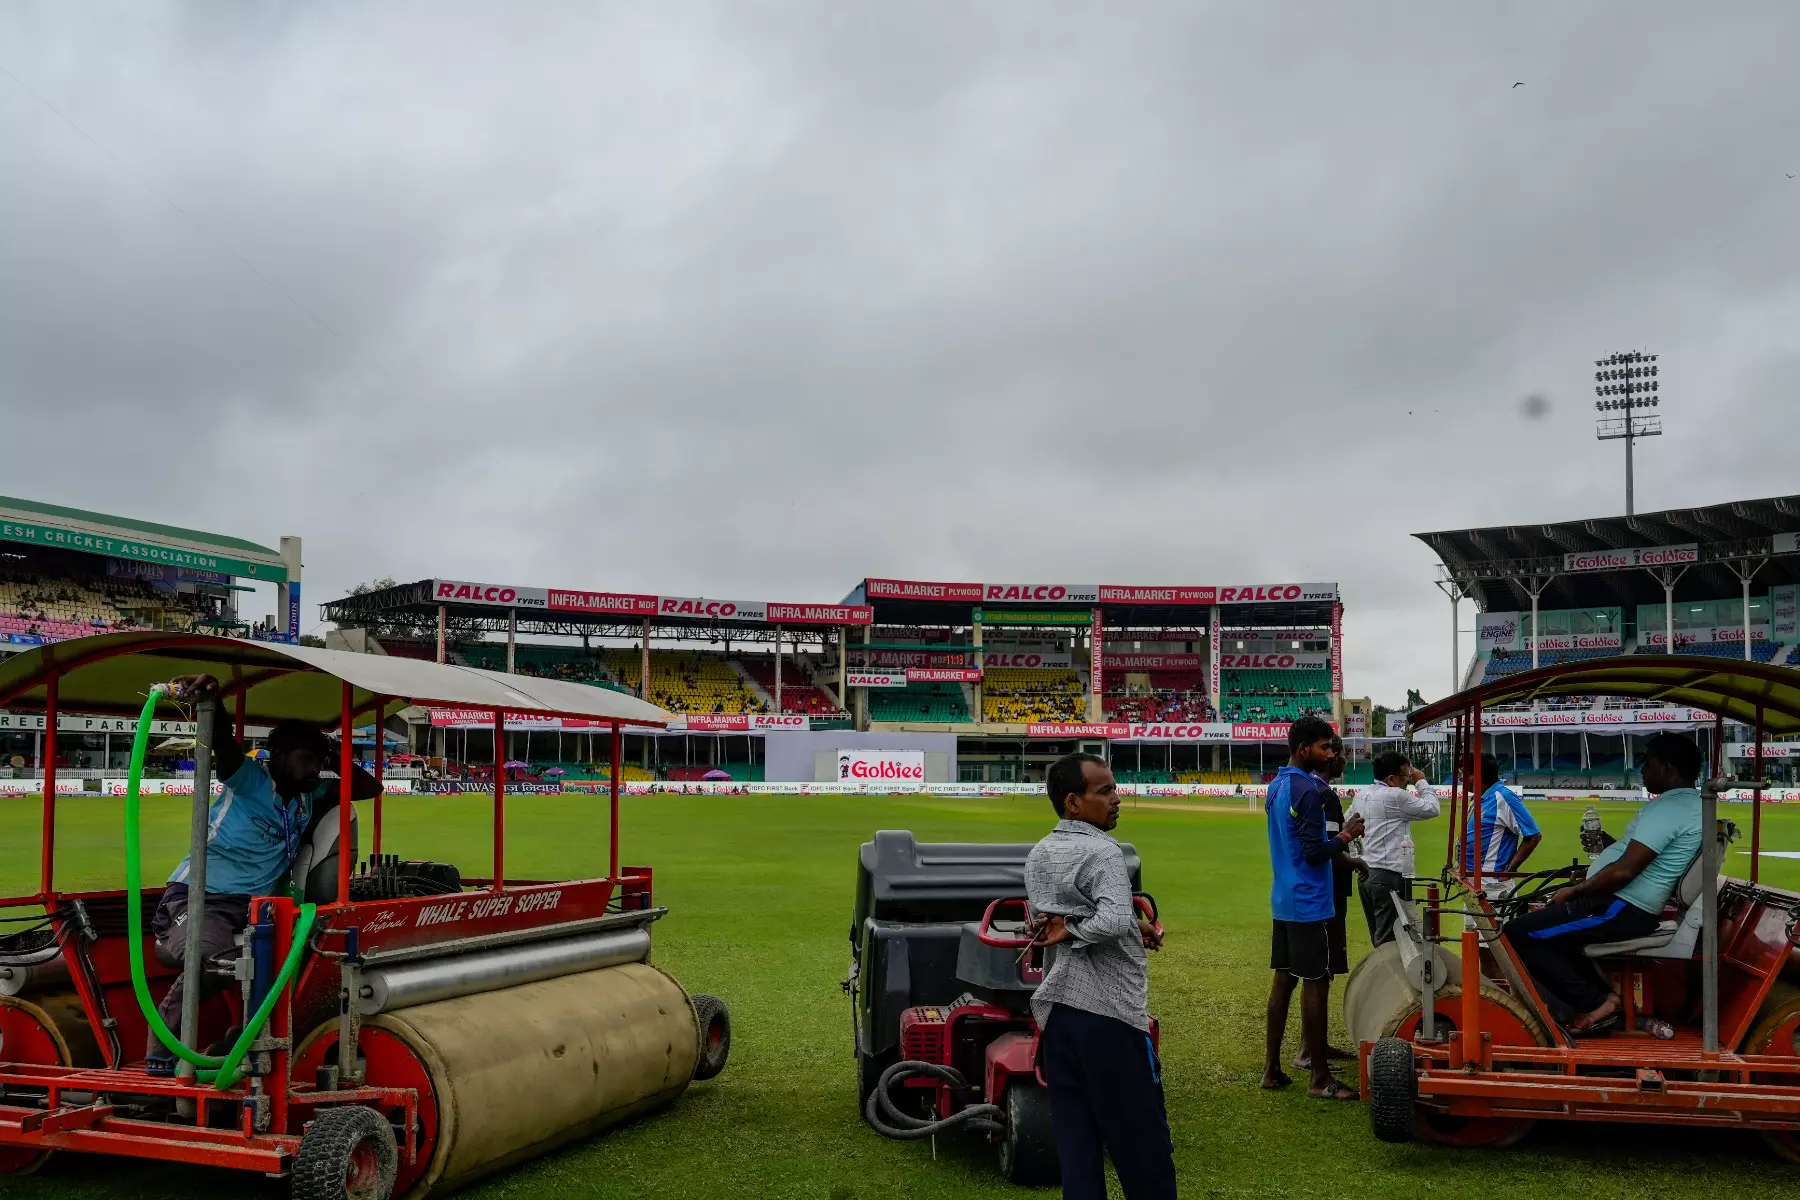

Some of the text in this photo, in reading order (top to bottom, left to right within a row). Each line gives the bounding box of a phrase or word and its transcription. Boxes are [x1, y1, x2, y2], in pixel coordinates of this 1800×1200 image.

[45, 531, 113, 550] CRICKET
[121, 544, 216, 568] ASSOCIATION
[1576, 555, 1628, 568] Goldiee
[1642, 550, 1694, 564] Goldiee
[436, 583, 546, 606] RALCO TYRES
[870, 582, 980, 596] INFRA.MARKET PLYWOOD
[986, 586, 1066, 600] RALCO
[1100, 588, 1214, 600] INFRA.MARKET PLYWOOD
[1219, 586, 1302, 602] RALCO
[551, 593, 656, 610] INFRA.MARKET MDF
[661, 600, 736, 616] RALCO
[769, 606, 870, 620] INFRA.MARKET MDF
[1480, 630, 1514, 640] ENGINE
[1652, 632, 1696, 644] Godiee
[1718, 629, 1764, 640] Goldee
[1578, 638, 1620, 648] Goldiee
[946, 654, 964, 664] 11:13
[1093, 637, 1102, 692] INFRA.MARKET
[1102, 657, 1163, 666] FRA.MARKET
[1220, 654, 1295, 668] RALCO
[848, 676, 890, 684] RALCO
[908, 670, 965, 680] INFRA.MARKET
[432, 712, 494, 720] INFRA.MARKET
[688, 716, 746, 724] INFRA.MARKET
[756, 716, 803, 725] RALCO
[1540, 714, 1576, 724] Goldiee
[1586, 714, 1623, 722] Goldiee
[1639, 711, 1677, 721] Goldiee
[86, 720, 138, 732] PARK
[1030, 725, 1108, 735] INFRA.MARKET
[1132, 726, 1203, 738] RALCO
[1234, 726, 1289, 738] INFRA.MA
[1746, 746, 1787, 756] Gldiee
[852, 760, 922, 778] Goldiee
[114, 784, 150, 794] Goee
[430, 782, 451, 792] RAJ
[456, 782, 496, 792] NIWAS
[415, 890, 562, 928] WHALE SUPER SOPPER
